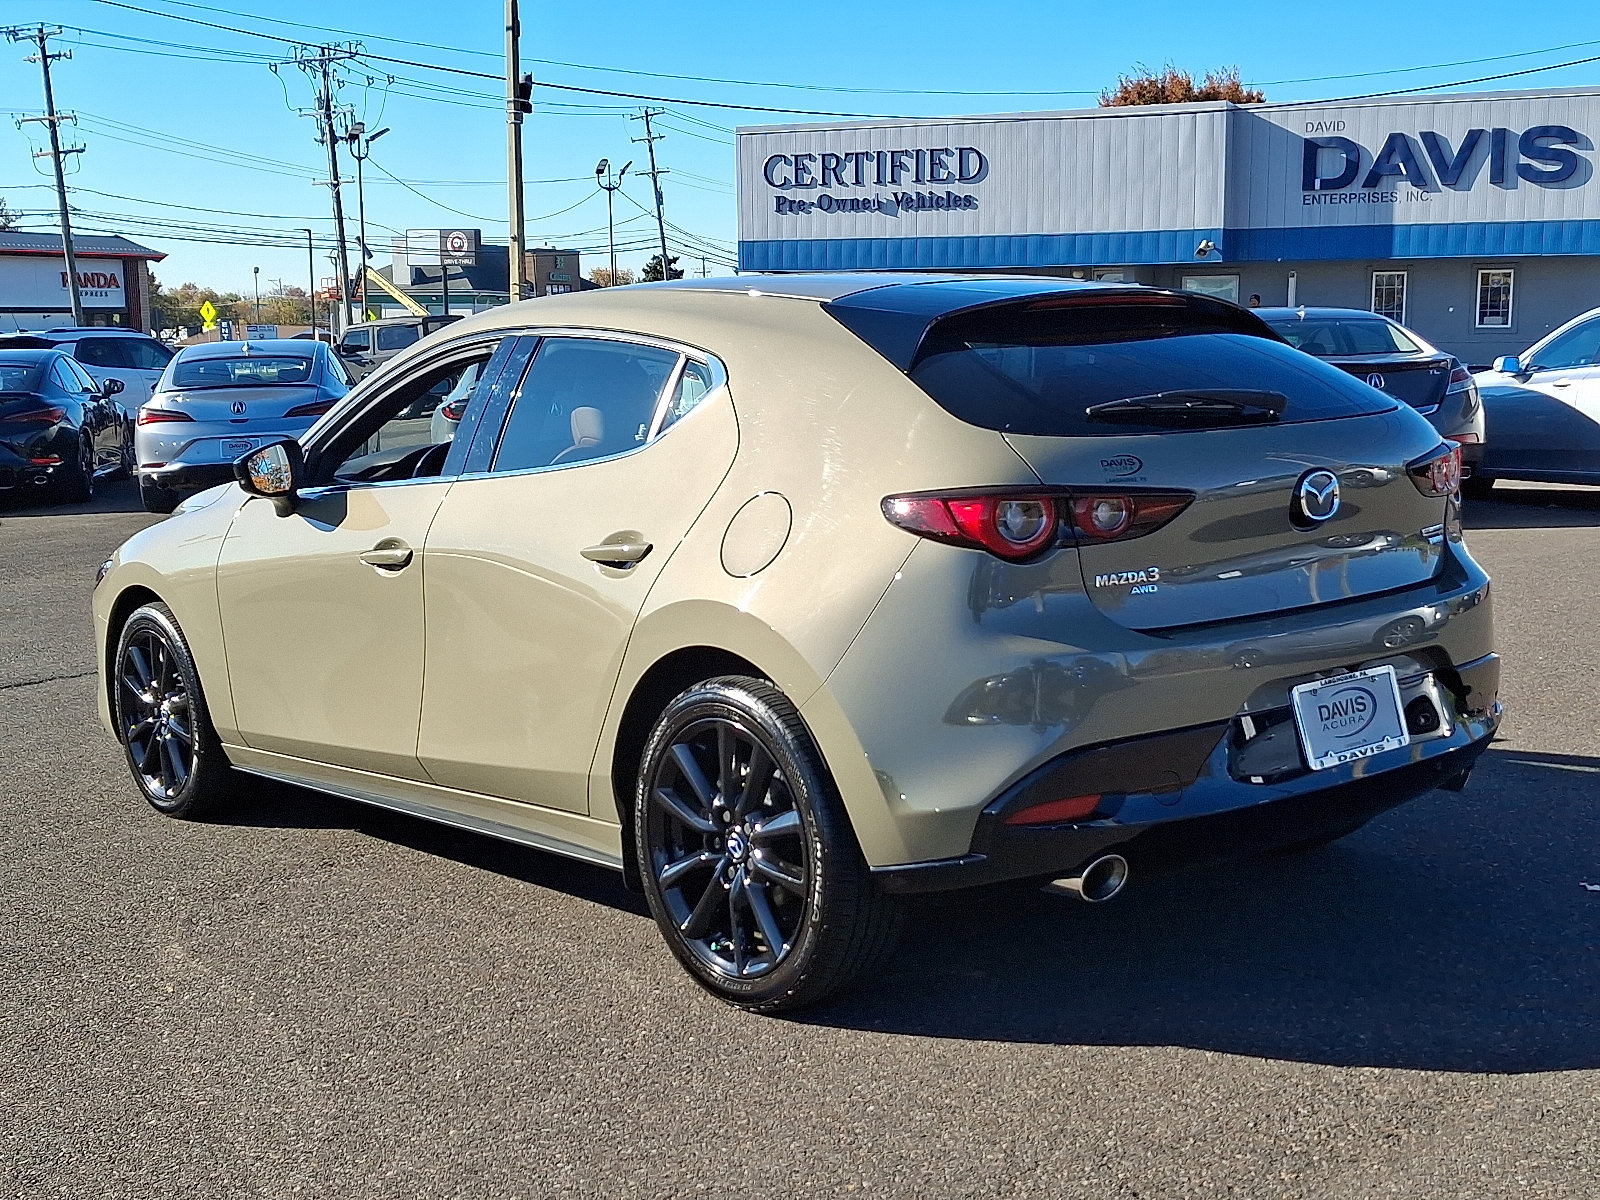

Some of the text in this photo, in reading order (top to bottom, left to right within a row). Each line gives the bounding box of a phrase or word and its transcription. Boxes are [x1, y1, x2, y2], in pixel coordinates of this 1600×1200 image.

[1304, 120, 1346, 133] DAVID
[1302, 124, 1578, 191] DAVIS
[763, 146, 988, 190] CERTIFIED
[774, 190, 976, 214] Pre-Owned Vehicles
[1302, 190, 1433, 206] ENTERPRISES, INC.
[79, 290, 108, 298] XPRESS
[1100, 458, 1136, 467] DAVIS
[1095, 566, 1160, 588] MAZDA3
[1130, 584, 1158, 595] AWD
[1318, 695, 1367, 722] DAVIS
[1322, 714, 1365, 732] ACURA
[1337, 744, 1385, 762] DAVIS
